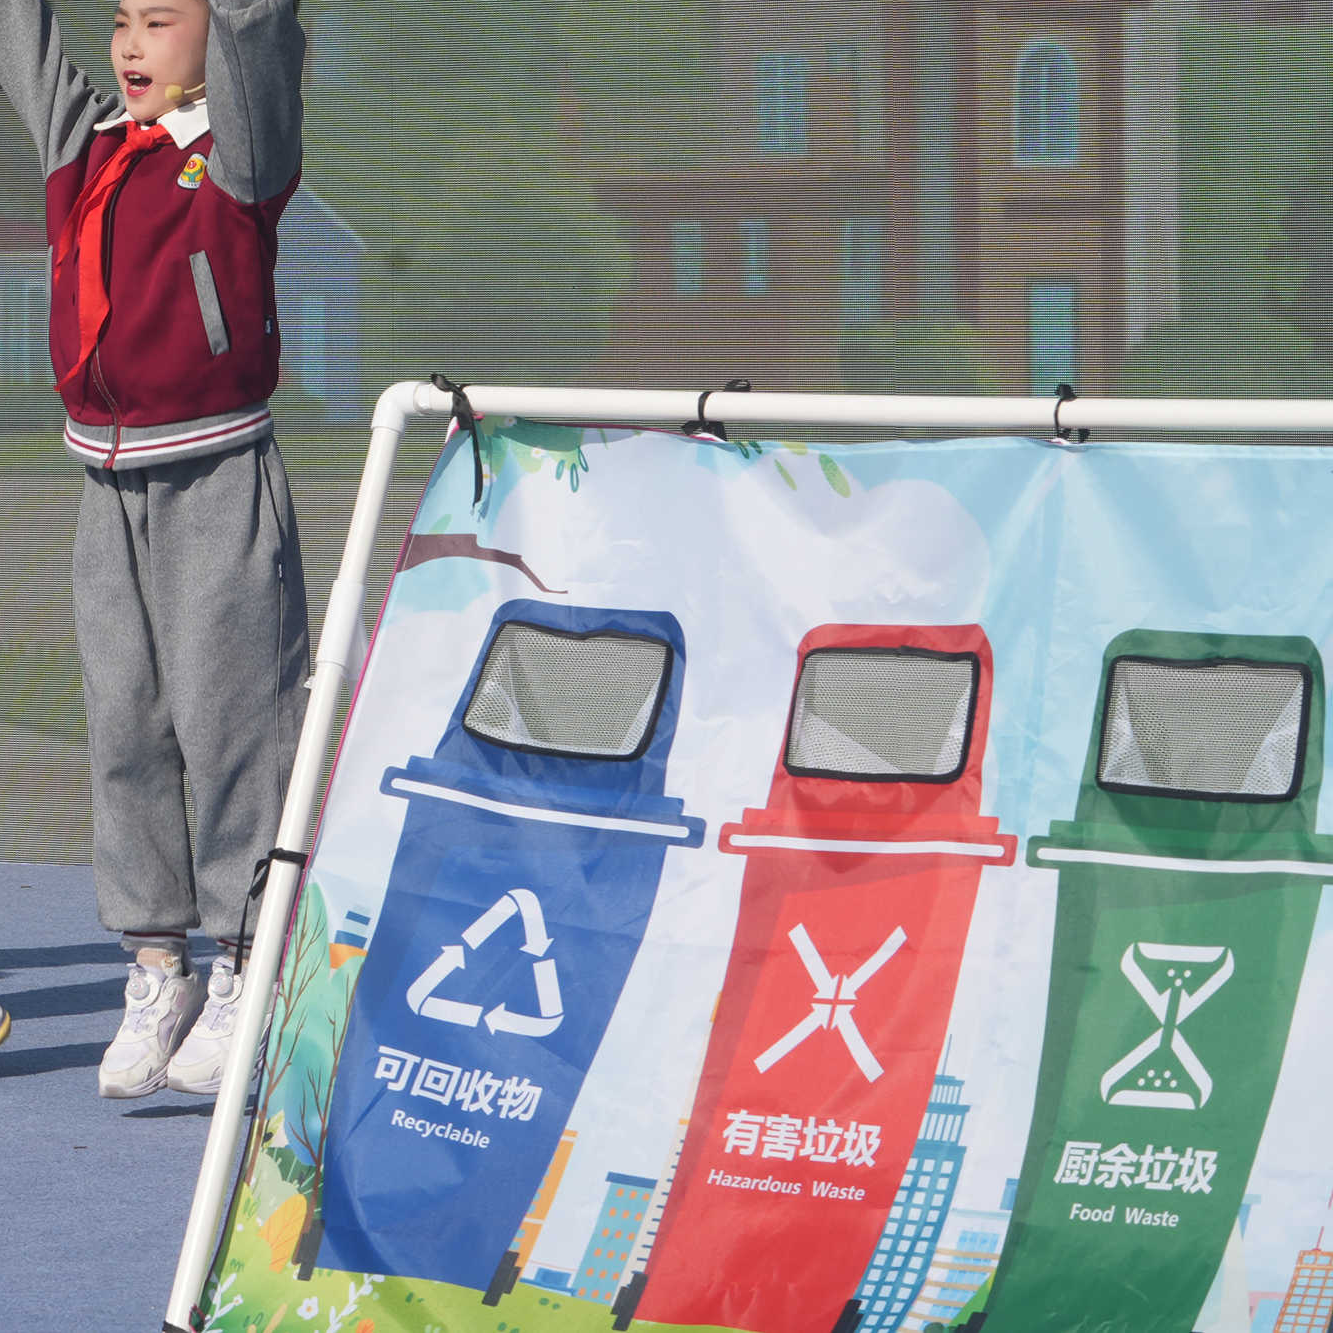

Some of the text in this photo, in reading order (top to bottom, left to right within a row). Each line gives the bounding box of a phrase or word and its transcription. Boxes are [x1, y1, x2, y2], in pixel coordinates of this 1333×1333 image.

[374, 1045, 543, 1122] 可回收物
[391, 1109, 491, 1149] Recyclable
[722, 1109, 882, 1168] 有害垃圾
[707, 1168, 866, 1201] Hazardous Waste
[1053, 1140, 1218, 1195] 厨余垃圾
[1069, 1203, 1180, 1227] Food Waste
